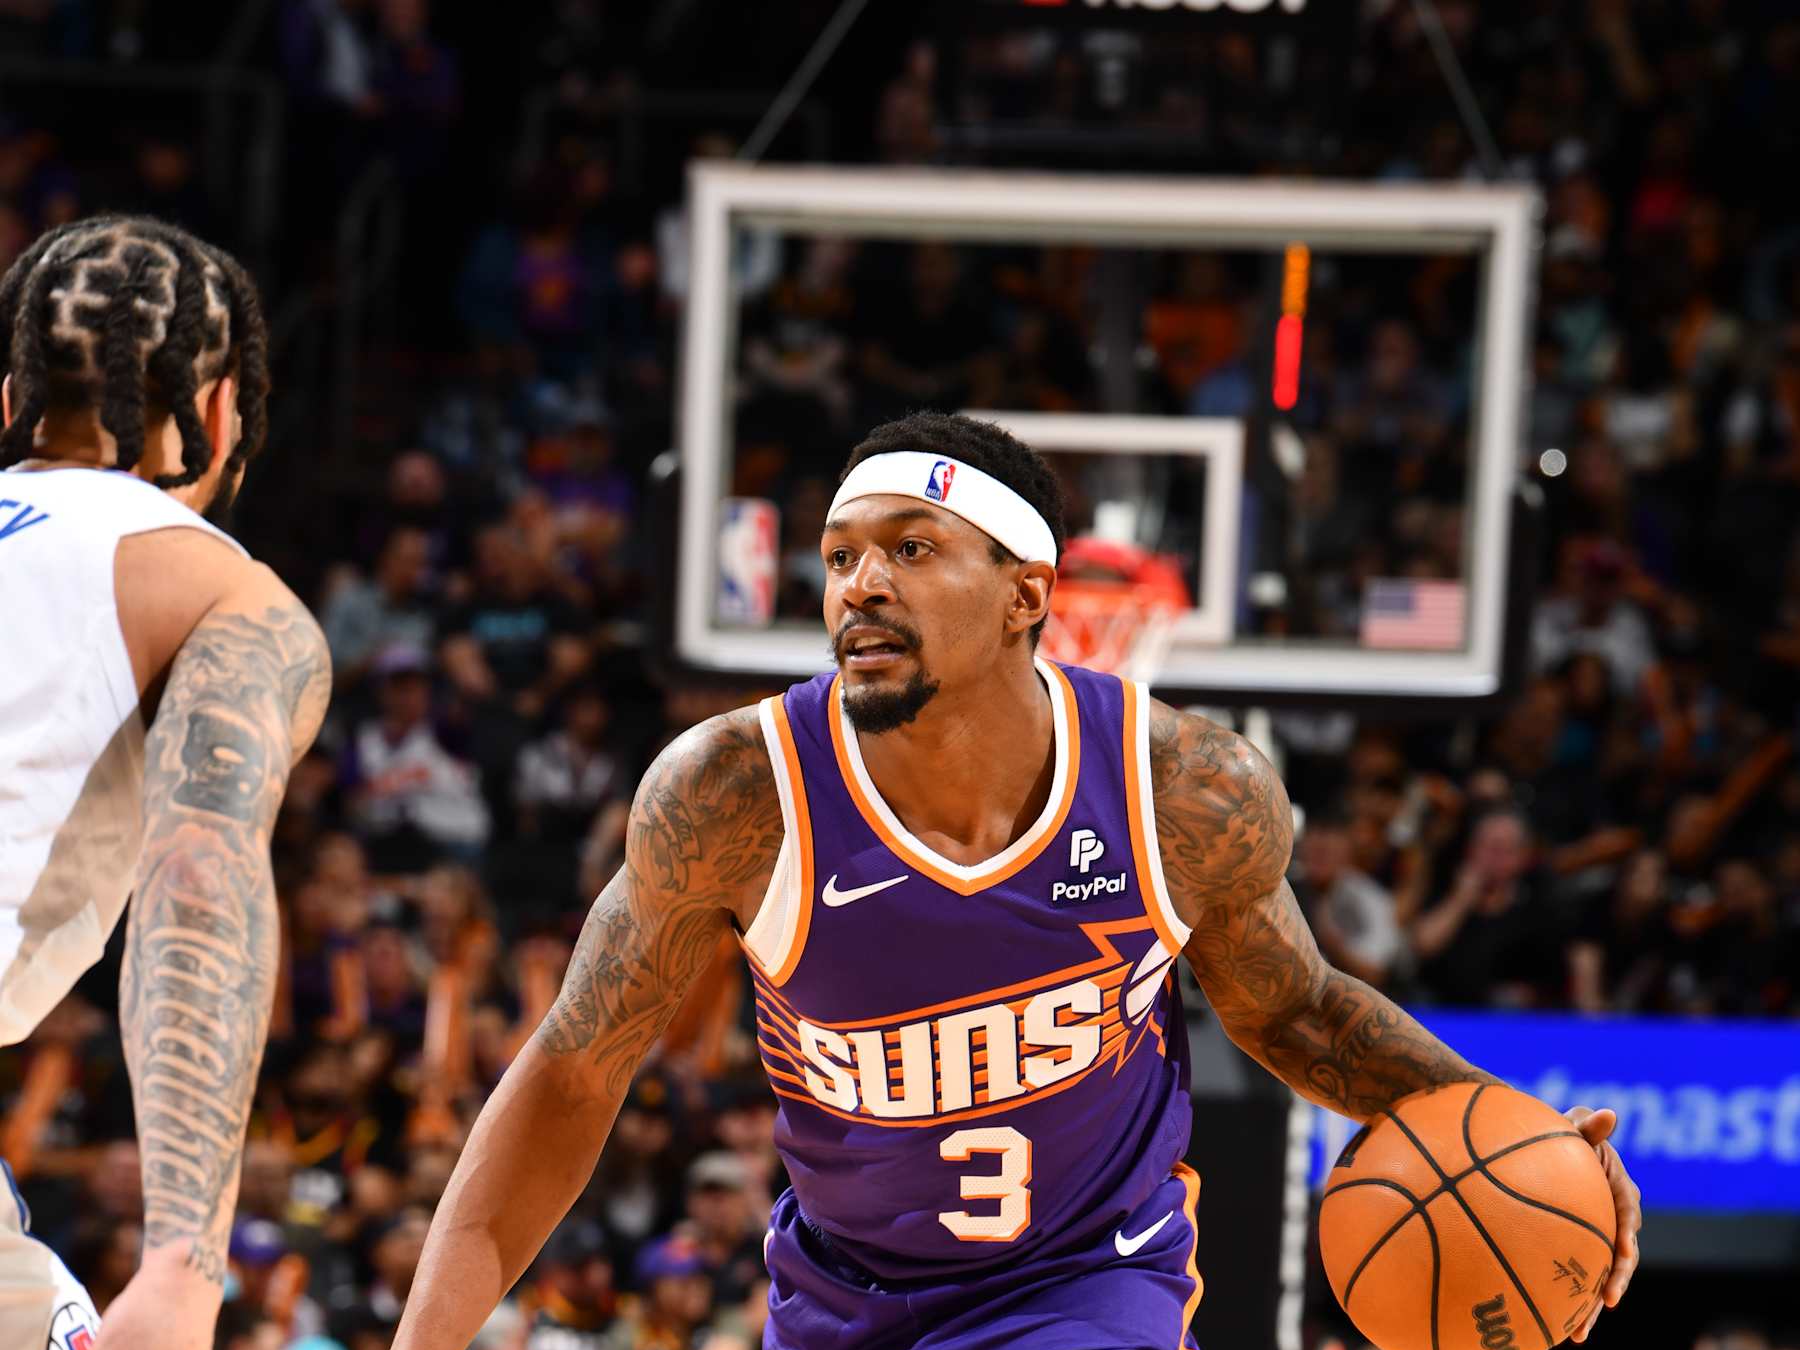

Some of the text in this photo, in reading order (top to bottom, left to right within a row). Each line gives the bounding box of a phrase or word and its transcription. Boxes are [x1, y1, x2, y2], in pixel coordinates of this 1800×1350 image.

[1052, 872, 1127, 902] PayPal
[797, 979, 1101, 1118] SUNS
[938, 1126, 1032, 1242] 3
